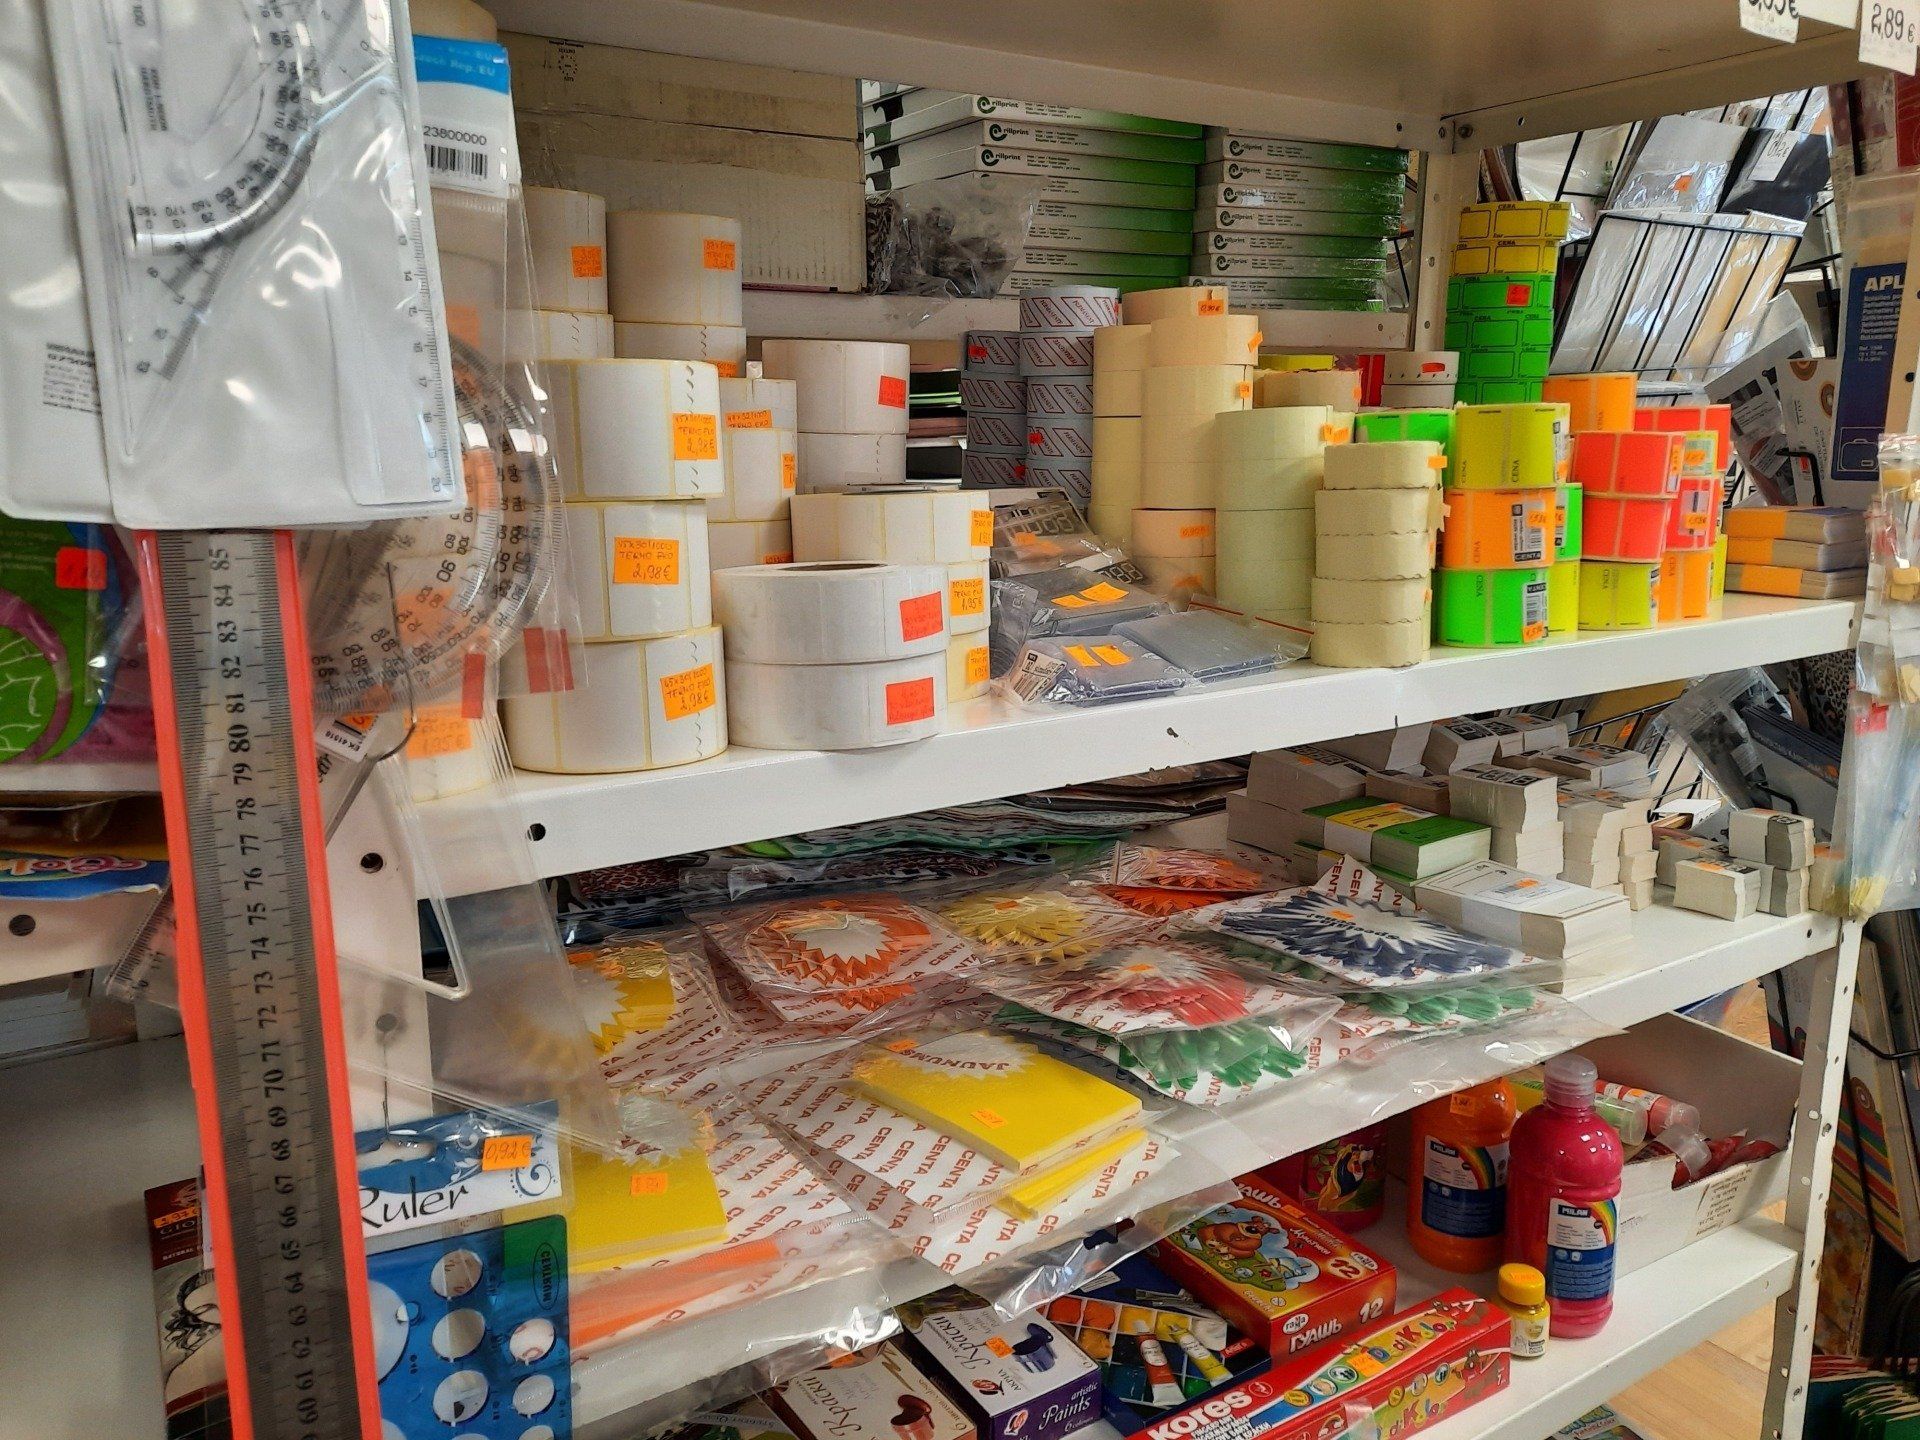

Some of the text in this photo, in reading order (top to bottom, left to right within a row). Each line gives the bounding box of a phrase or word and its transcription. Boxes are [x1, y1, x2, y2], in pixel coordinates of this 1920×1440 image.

[1512, 459, 1520, 483] CENA
[209, 548, 230, 571] 85
[213, 584, 234, 607] 84
[217, 620, 238, 643] 83
[221, 656, 242, 680] 82
[225, 693, 246, 714] 81
[228, 724, 250, 753] 80
[233, 763, 253, 785] 79
[236, 797, 256, 821] 78
[240, 833, 260, 856] 77
[243, 867, 263, 891] 76
[1349, 868, 1363, 898] CEN
[247, 901, 267, 926] 75
[251, 936, 270, 960] 74
[254, 970, 274, 994] 73
[257, 1004, 277, 1030] 72
[261, 1040, 280, 1062] 71
[900, 1048, 1010, 1071] JAUNUMS
[263, 1068, 285, 1099] 70
[779, 1076, 820, 1107] CENTA
[798, 1085, 839, 1119] CENTA
[268, 1105, 288, 1128] 69
[270, 1138, 291, 1162] 68
[852, 1127, 893, 1160] CENTA
[914, 1134, 953, 1176] CENTA
[1432, 1142, 1456, 1155] MILAN
[874, 1140, 915, 1174] CENTA
[939, 1150, 977, 1190] CENTA
[274, 1173, 295, 1196] 67
[278, 1205, 298, 1228] 66
[1561, 1206, 1589, 1218] MILAN
[723, 1205, 788, 1246] CENTA
[955, 1205, 993, 1245] ENTA
[281, 1239, 300, 1261] 65
[1331, 1258, 1361, 1279] 12
[284, 1272, 305, 1294] 64
[288, 1304, 307, 1327] 63
[1360, 1297, 1384, 1324] 12
[291, 1336, 311, 1359] 62
[1290, 1318, 1343, 1354] ГУАШЬ
[295, 1368, 315, 1391] 61
[1071, 1382, 1100, 1401] artistic
[298, 1397, 319, 1425] 60
[1039, 1395, 1093, 1431] Paints
